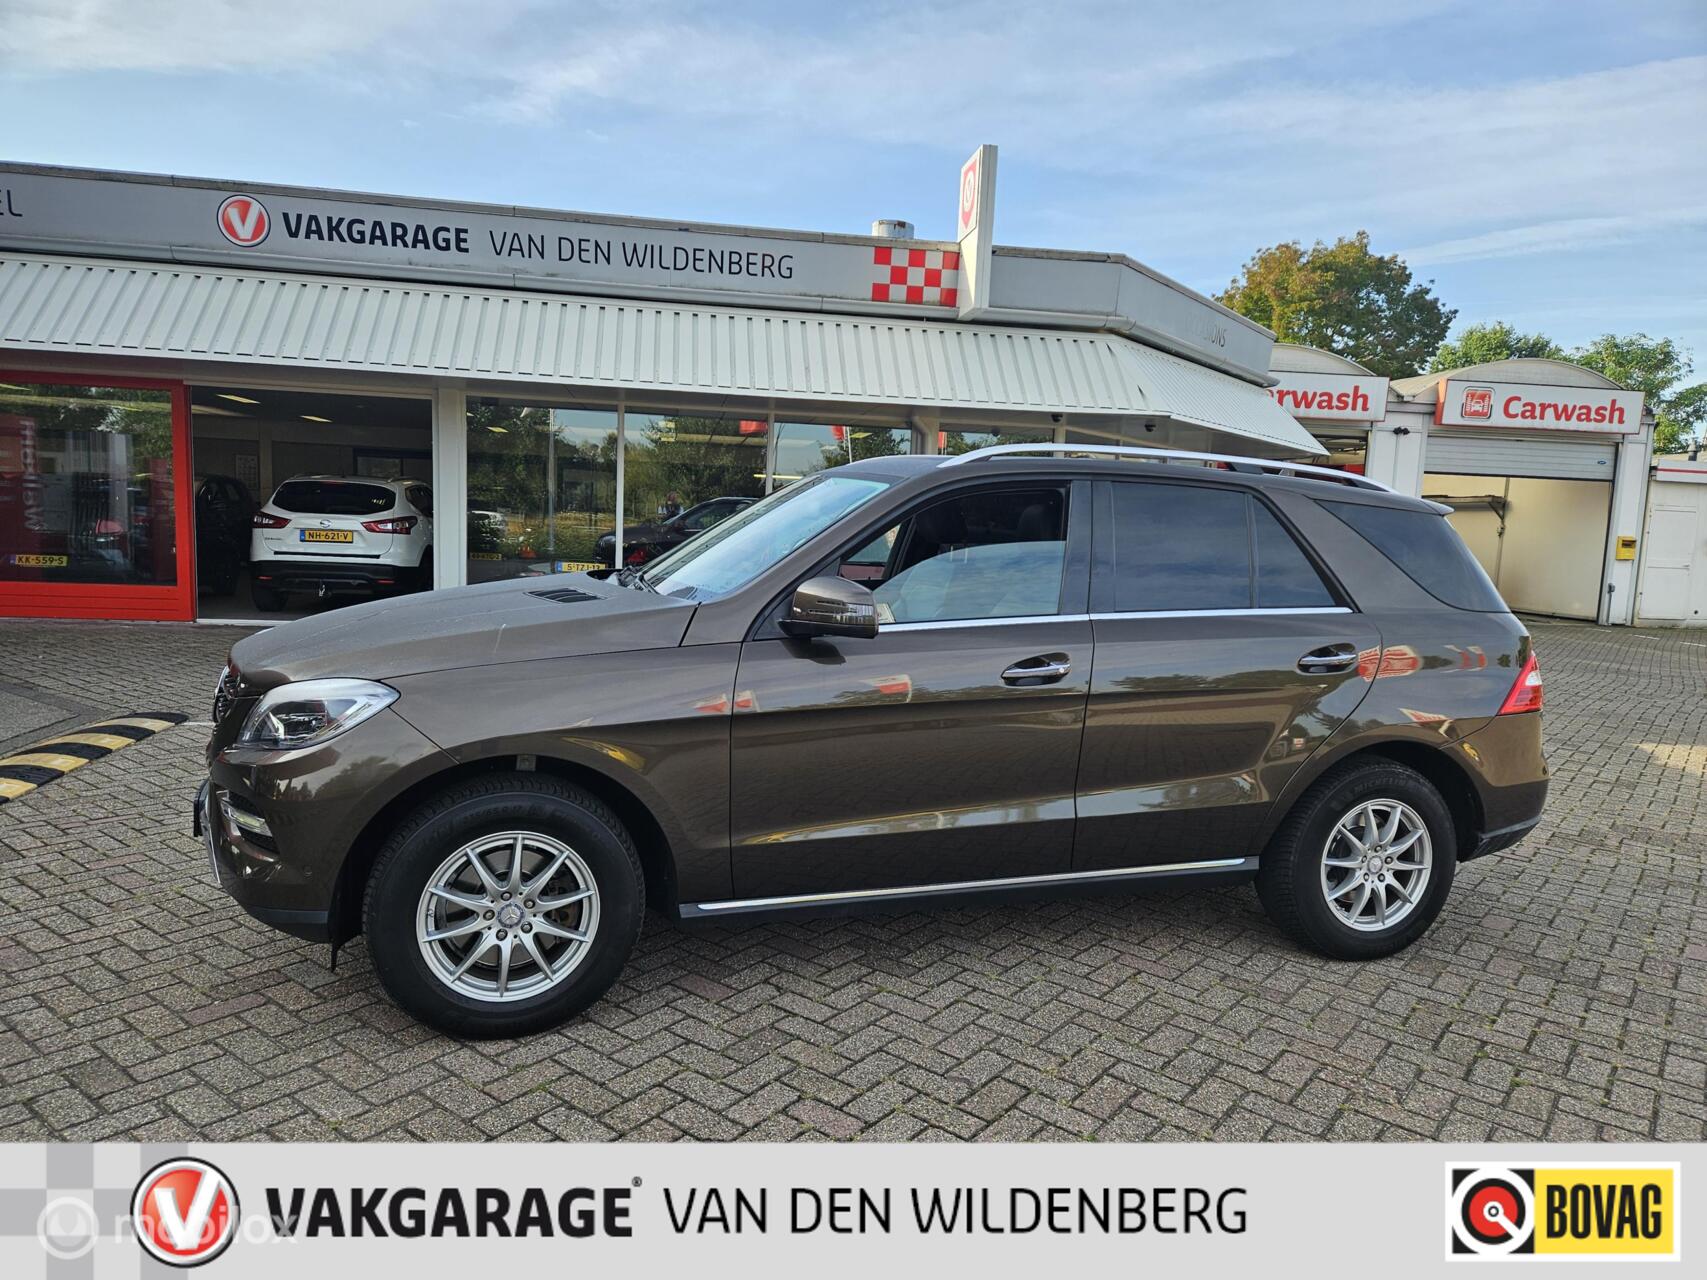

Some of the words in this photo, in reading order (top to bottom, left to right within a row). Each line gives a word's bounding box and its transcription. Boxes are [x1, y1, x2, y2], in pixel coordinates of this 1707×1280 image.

[282, 211, 470, 253] VAKGARAGE
[489, 230, 545, 259] VAN
[558, 236, 611, 265] DEN
[622, 241, 794, 279] WILDENBERG
[1503, 395, 1625, 425] Carwash
[308, 530, 349, 541] NH-621-V
[17, 556, 64, 565] KK-559-S
